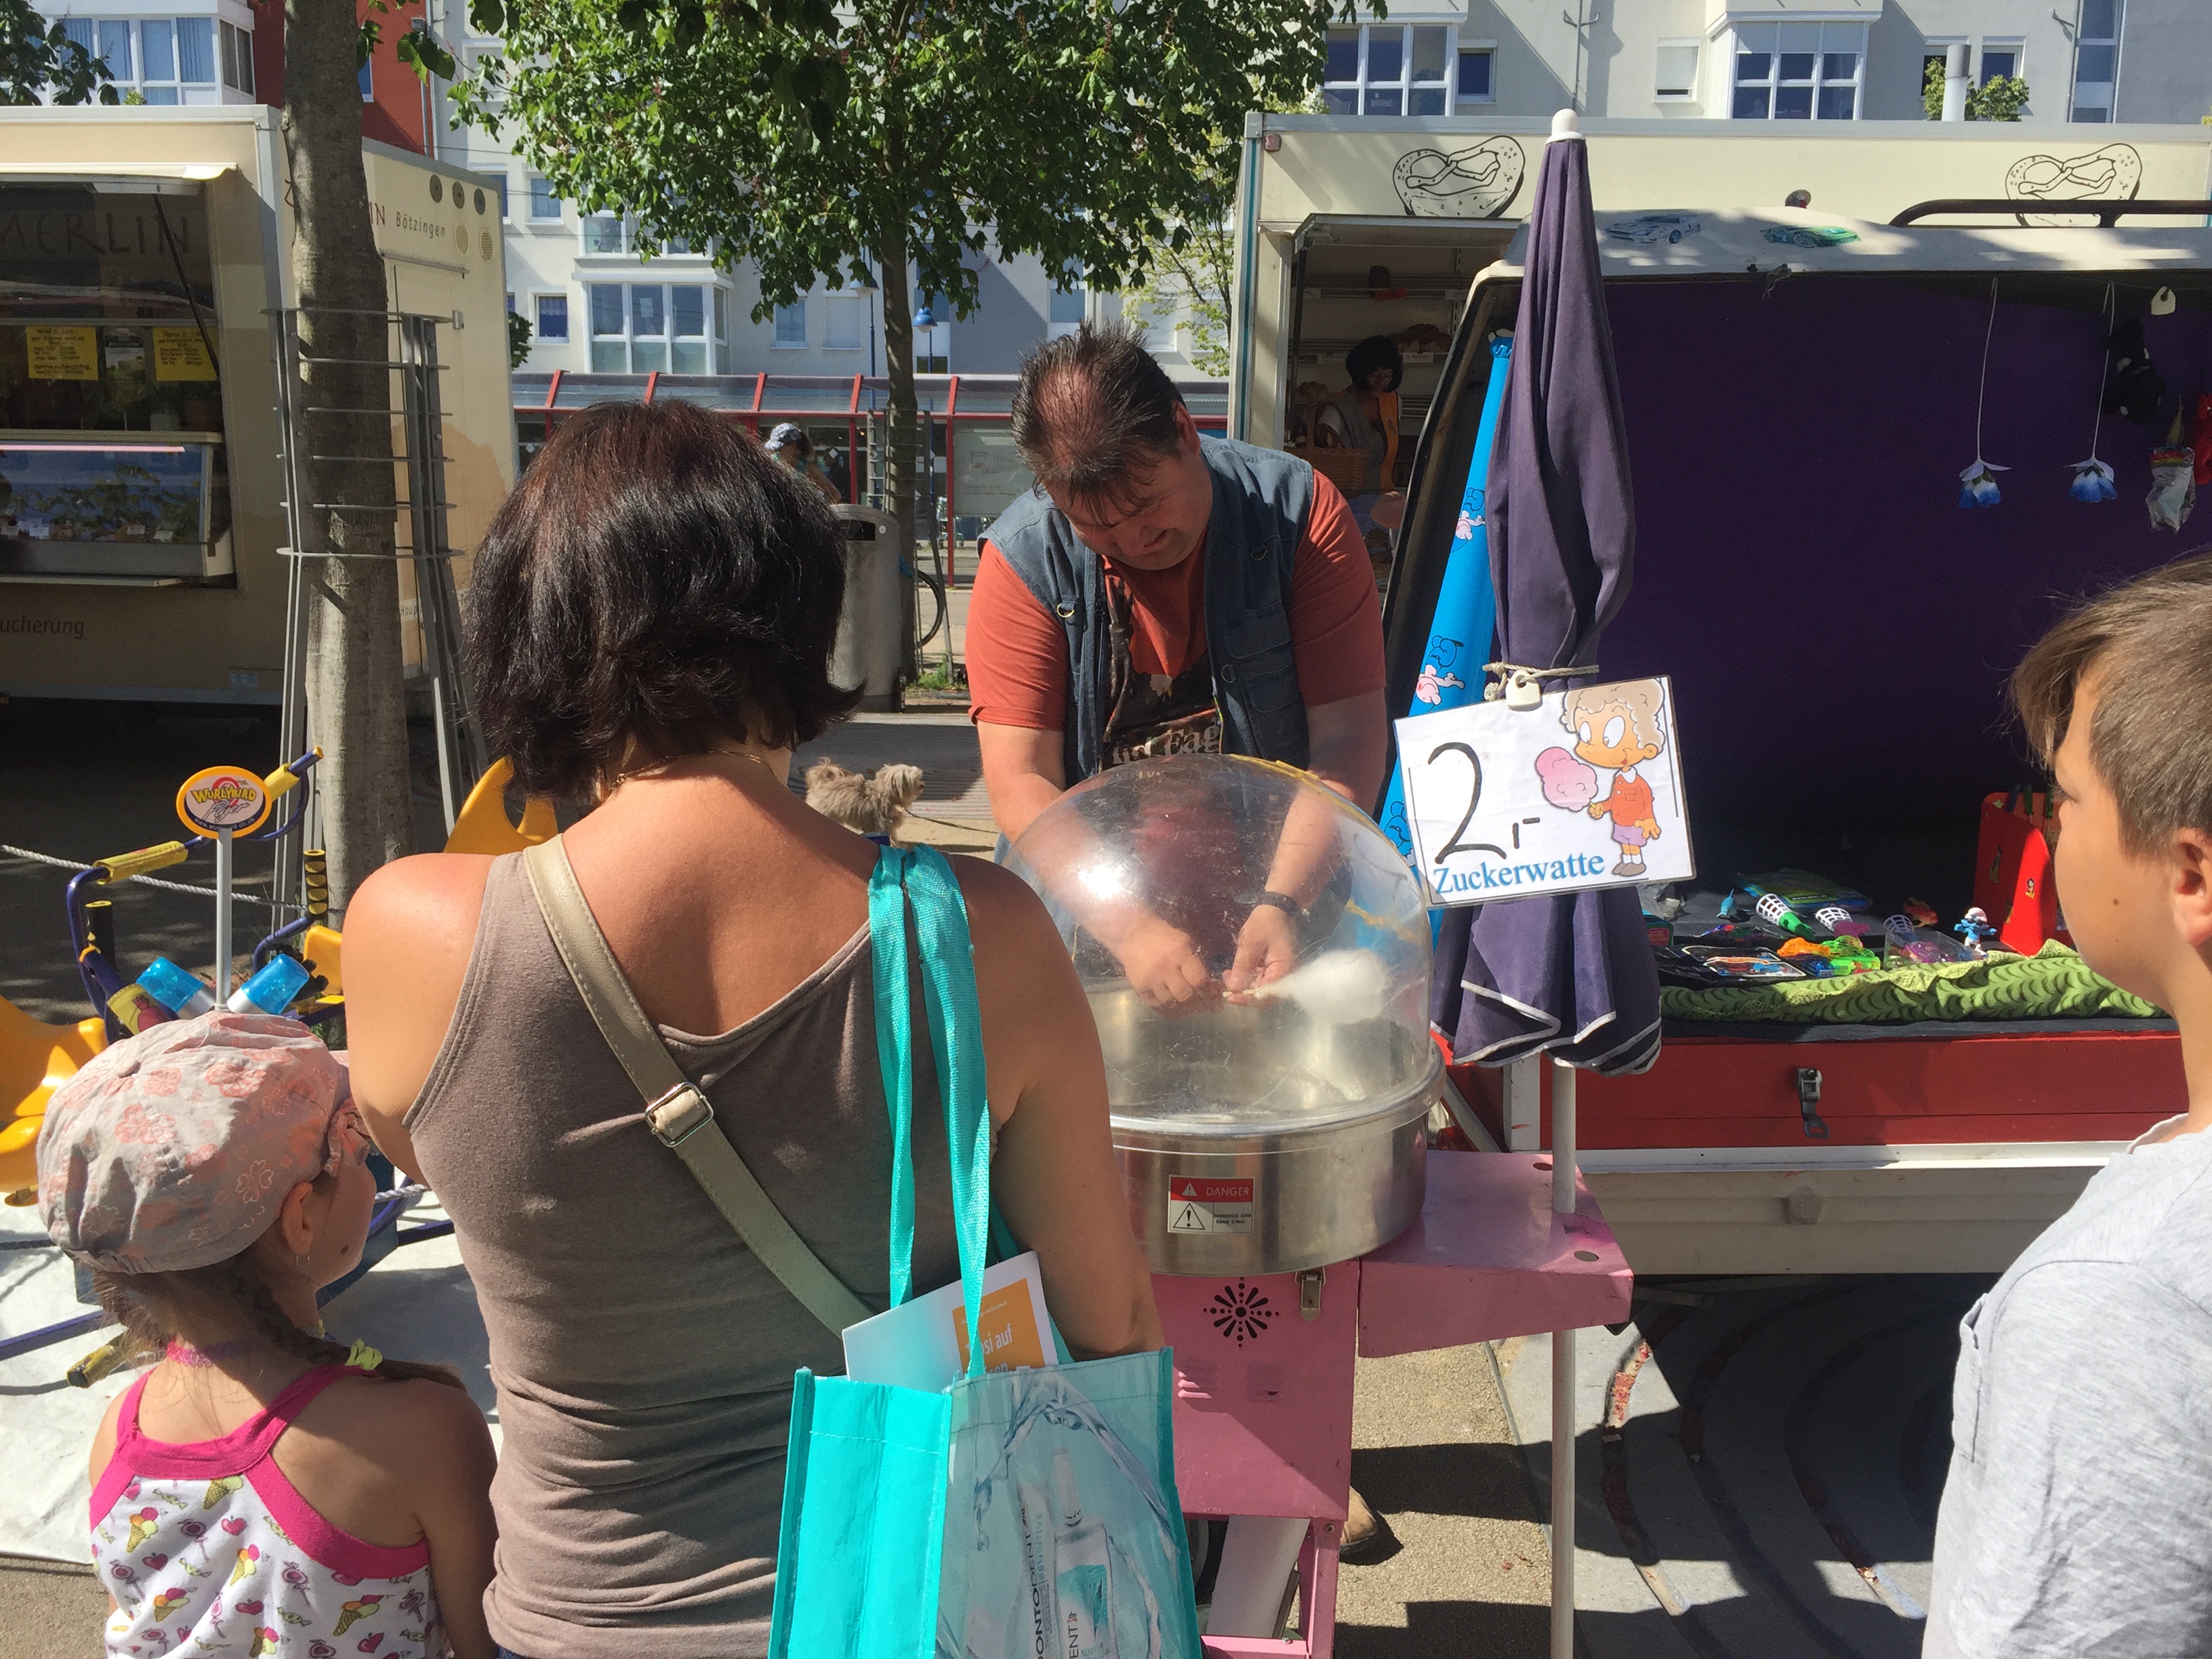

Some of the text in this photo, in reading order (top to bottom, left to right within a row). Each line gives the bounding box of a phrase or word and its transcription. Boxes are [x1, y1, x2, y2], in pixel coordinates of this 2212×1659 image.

[396, 211, 446, 239] Bötzingen
[1433, 853, 1606, 895] Zuckerwatte
[1206, 1187, 1250, 1196] DANGER
[995, 1322, 1013, 1349] auf
